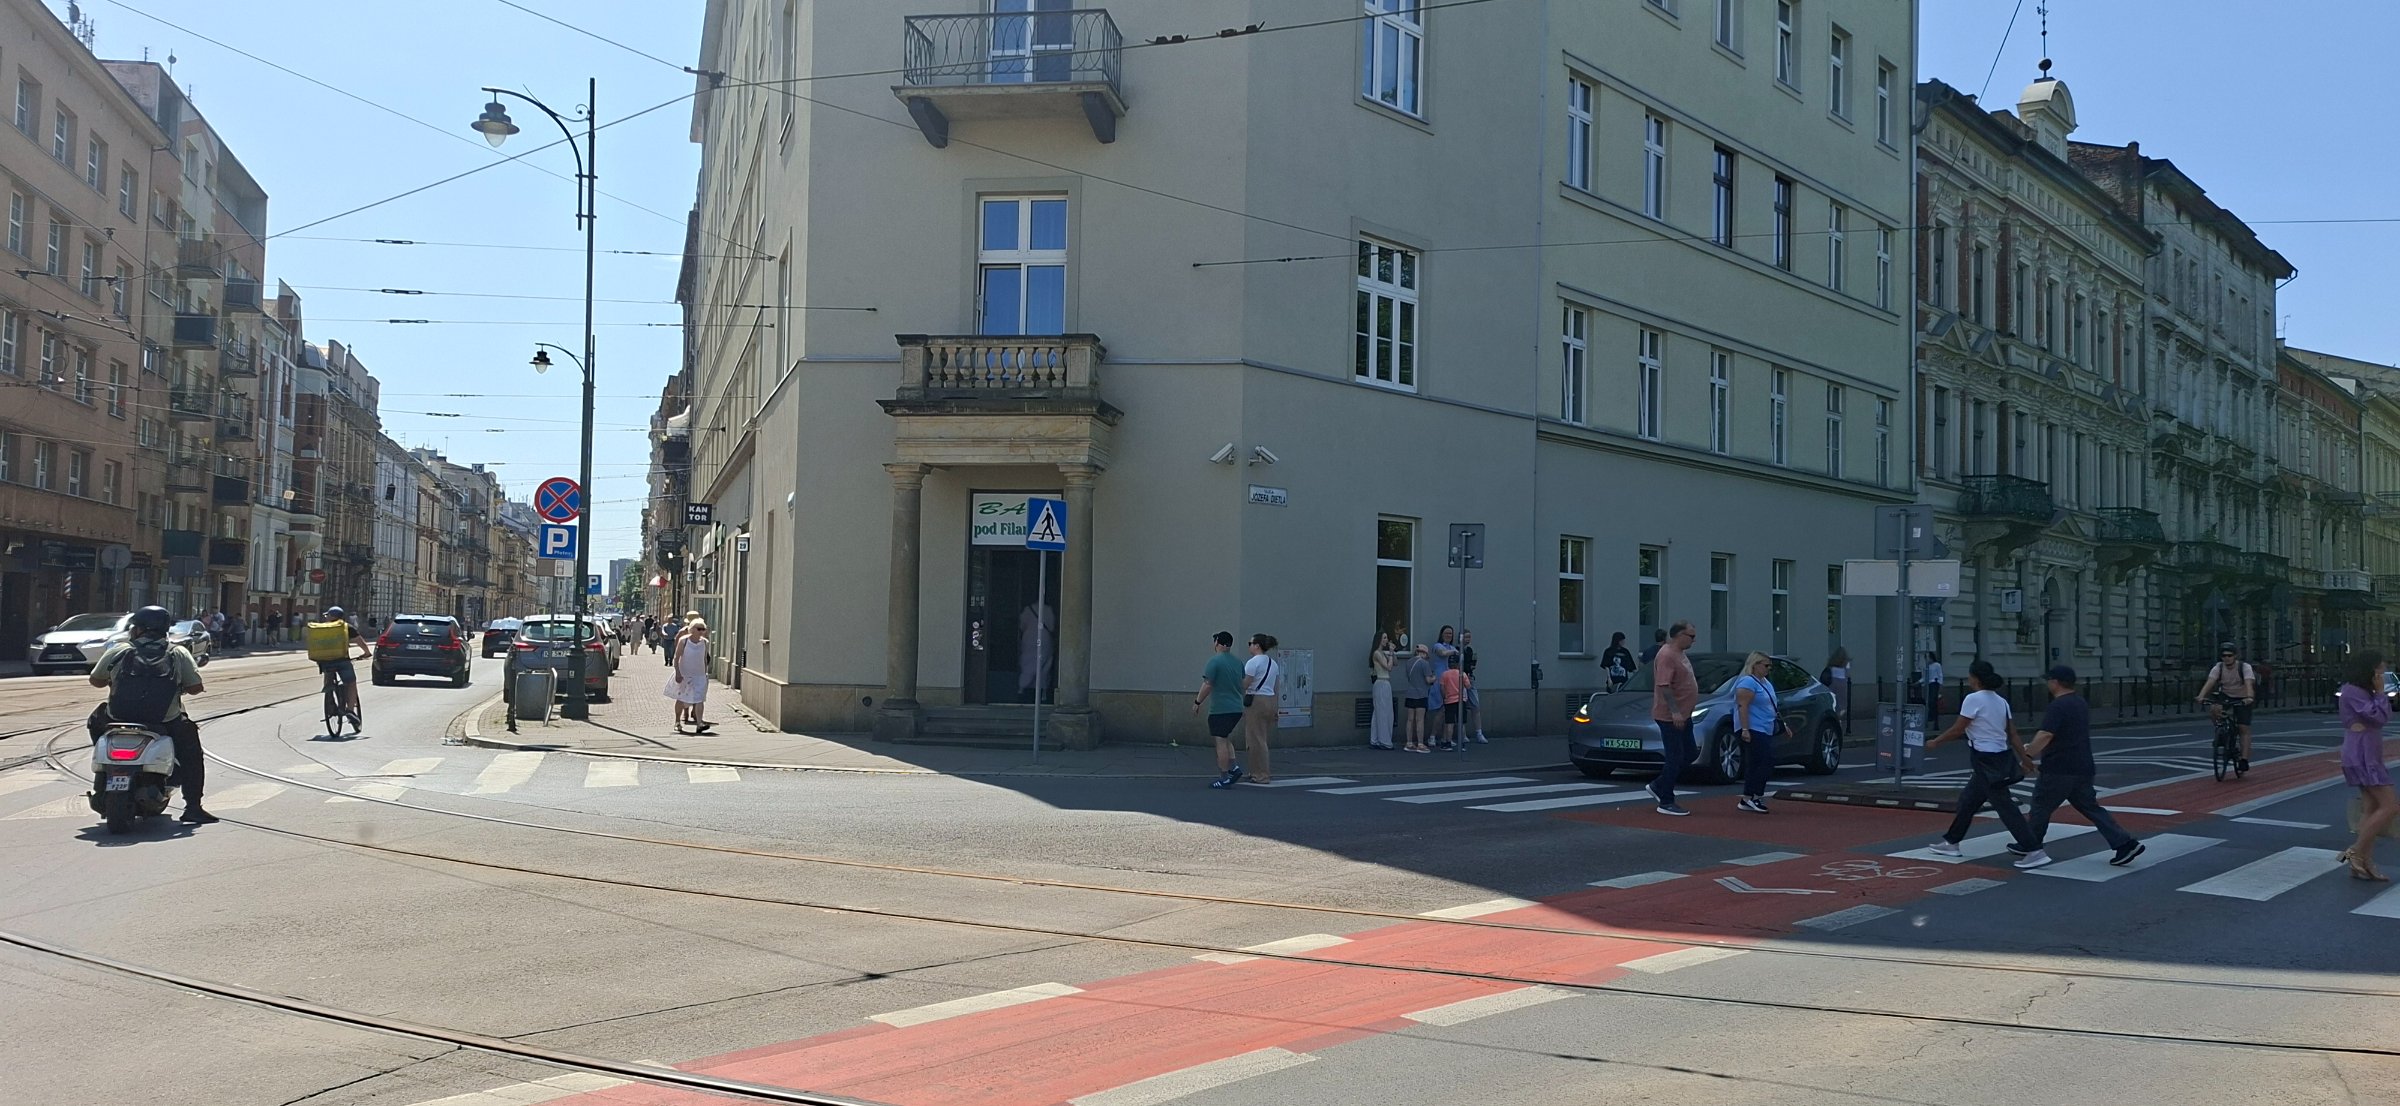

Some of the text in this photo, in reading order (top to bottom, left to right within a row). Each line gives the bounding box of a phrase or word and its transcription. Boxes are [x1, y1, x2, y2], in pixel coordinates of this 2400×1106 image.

[1270, 494, 1286, 504] DIETLA
[688, 505, 708, 513] KAN
[978, 502, 1026, 516] BA
[974, 522, 997, 538] pod
[546, 528, 569, 555] P
[588, 576, 599, 589] P
